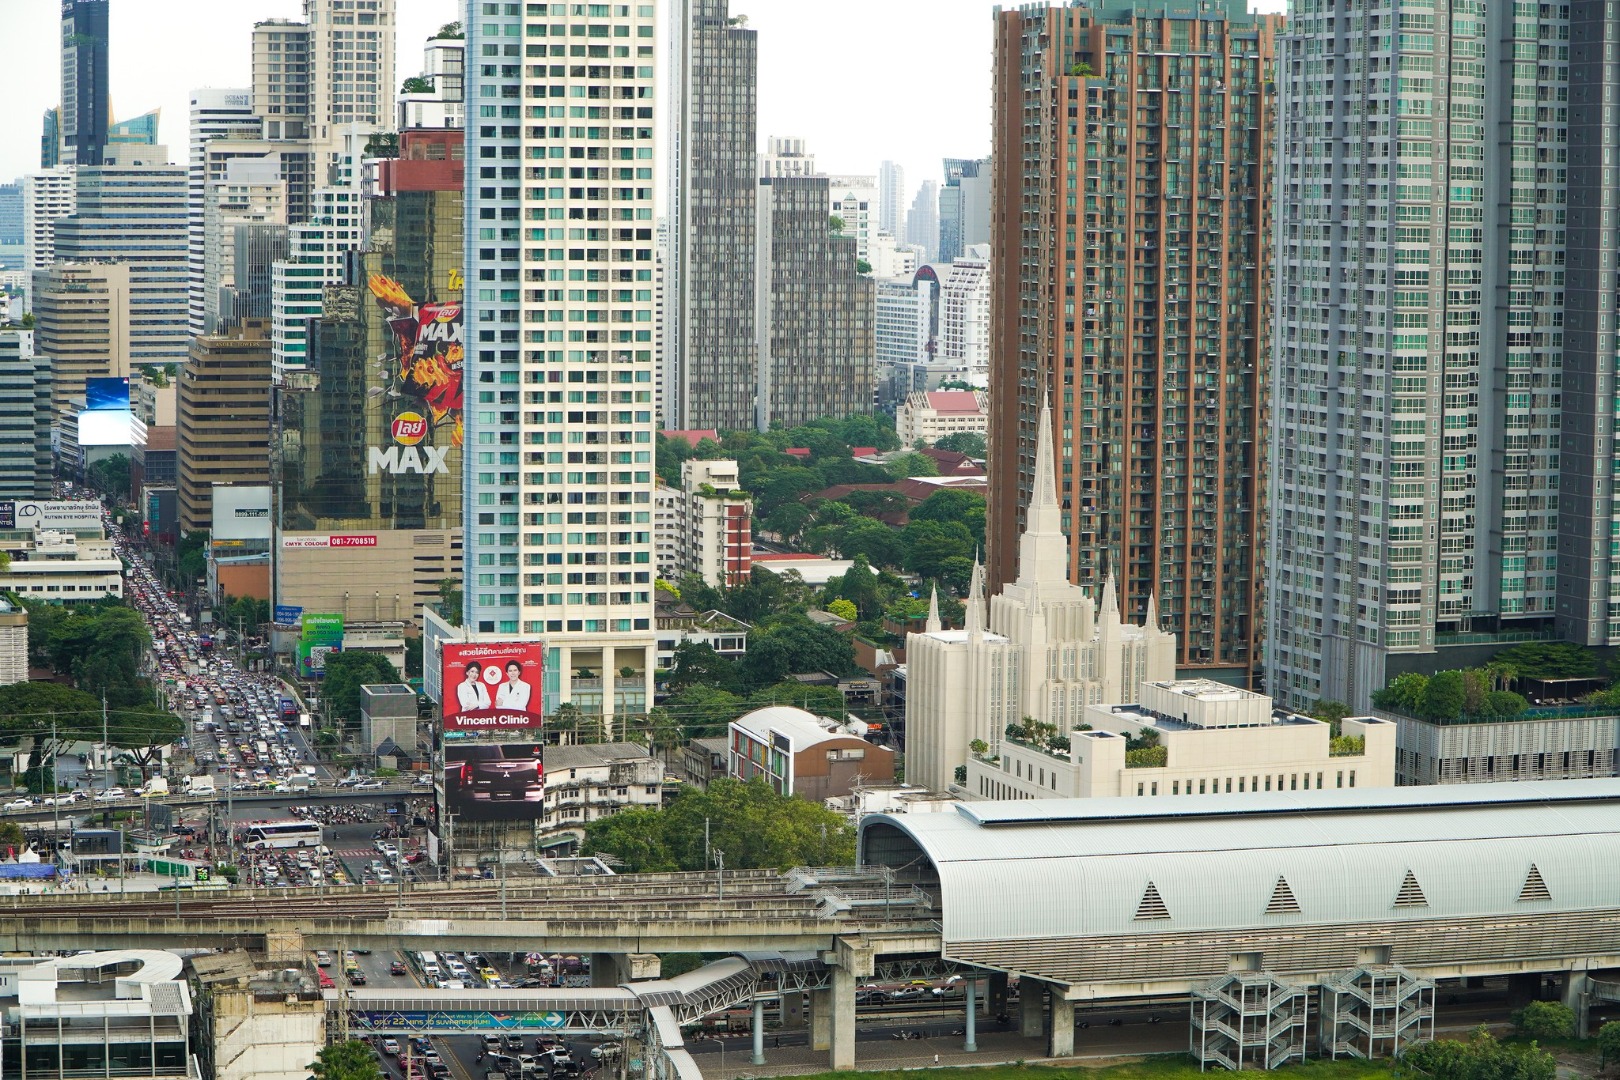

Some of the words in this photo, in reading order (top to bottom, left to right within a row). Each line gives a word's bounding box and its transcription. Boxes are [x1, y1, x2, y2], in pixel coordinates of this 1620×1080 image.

[419, 322, 464, 342] MAX
[368, 446, 450, 474] MAX
[331, 537, 375, 545] 081-7708518
[456, 715, 497, 725] Vincent
[499, 714, 529, 725] Clinic
[197, 872, 208, 880] 5G
[392, 1017, 405, 1026] 22
